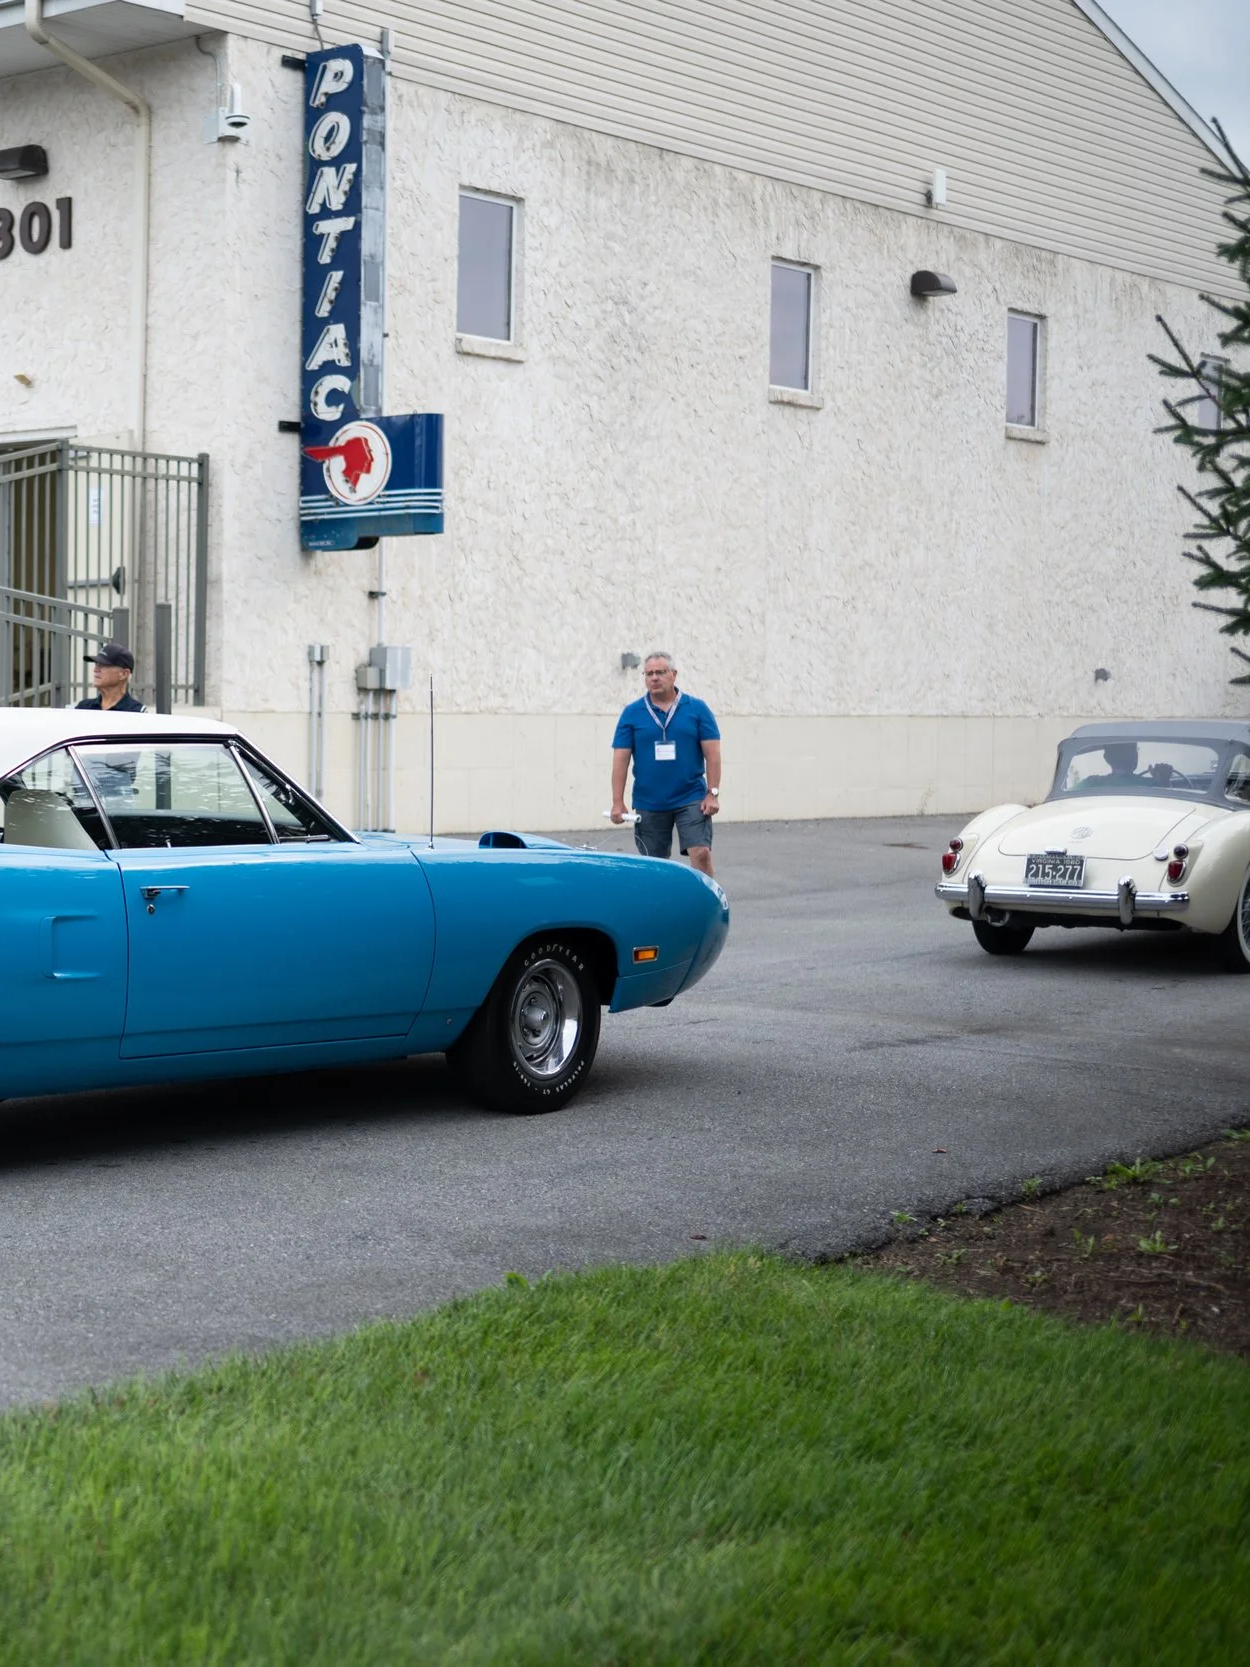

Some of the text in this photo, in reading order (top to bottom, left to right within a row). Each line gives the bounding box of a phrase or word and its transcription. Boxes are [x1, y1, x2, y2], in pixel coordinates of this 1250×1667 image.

[306, 57, 357, 421] PONTIAC
[524, 944, 584, 971] GOODYEAR
[556, 1060, 585, 1093] POLYGLAS
